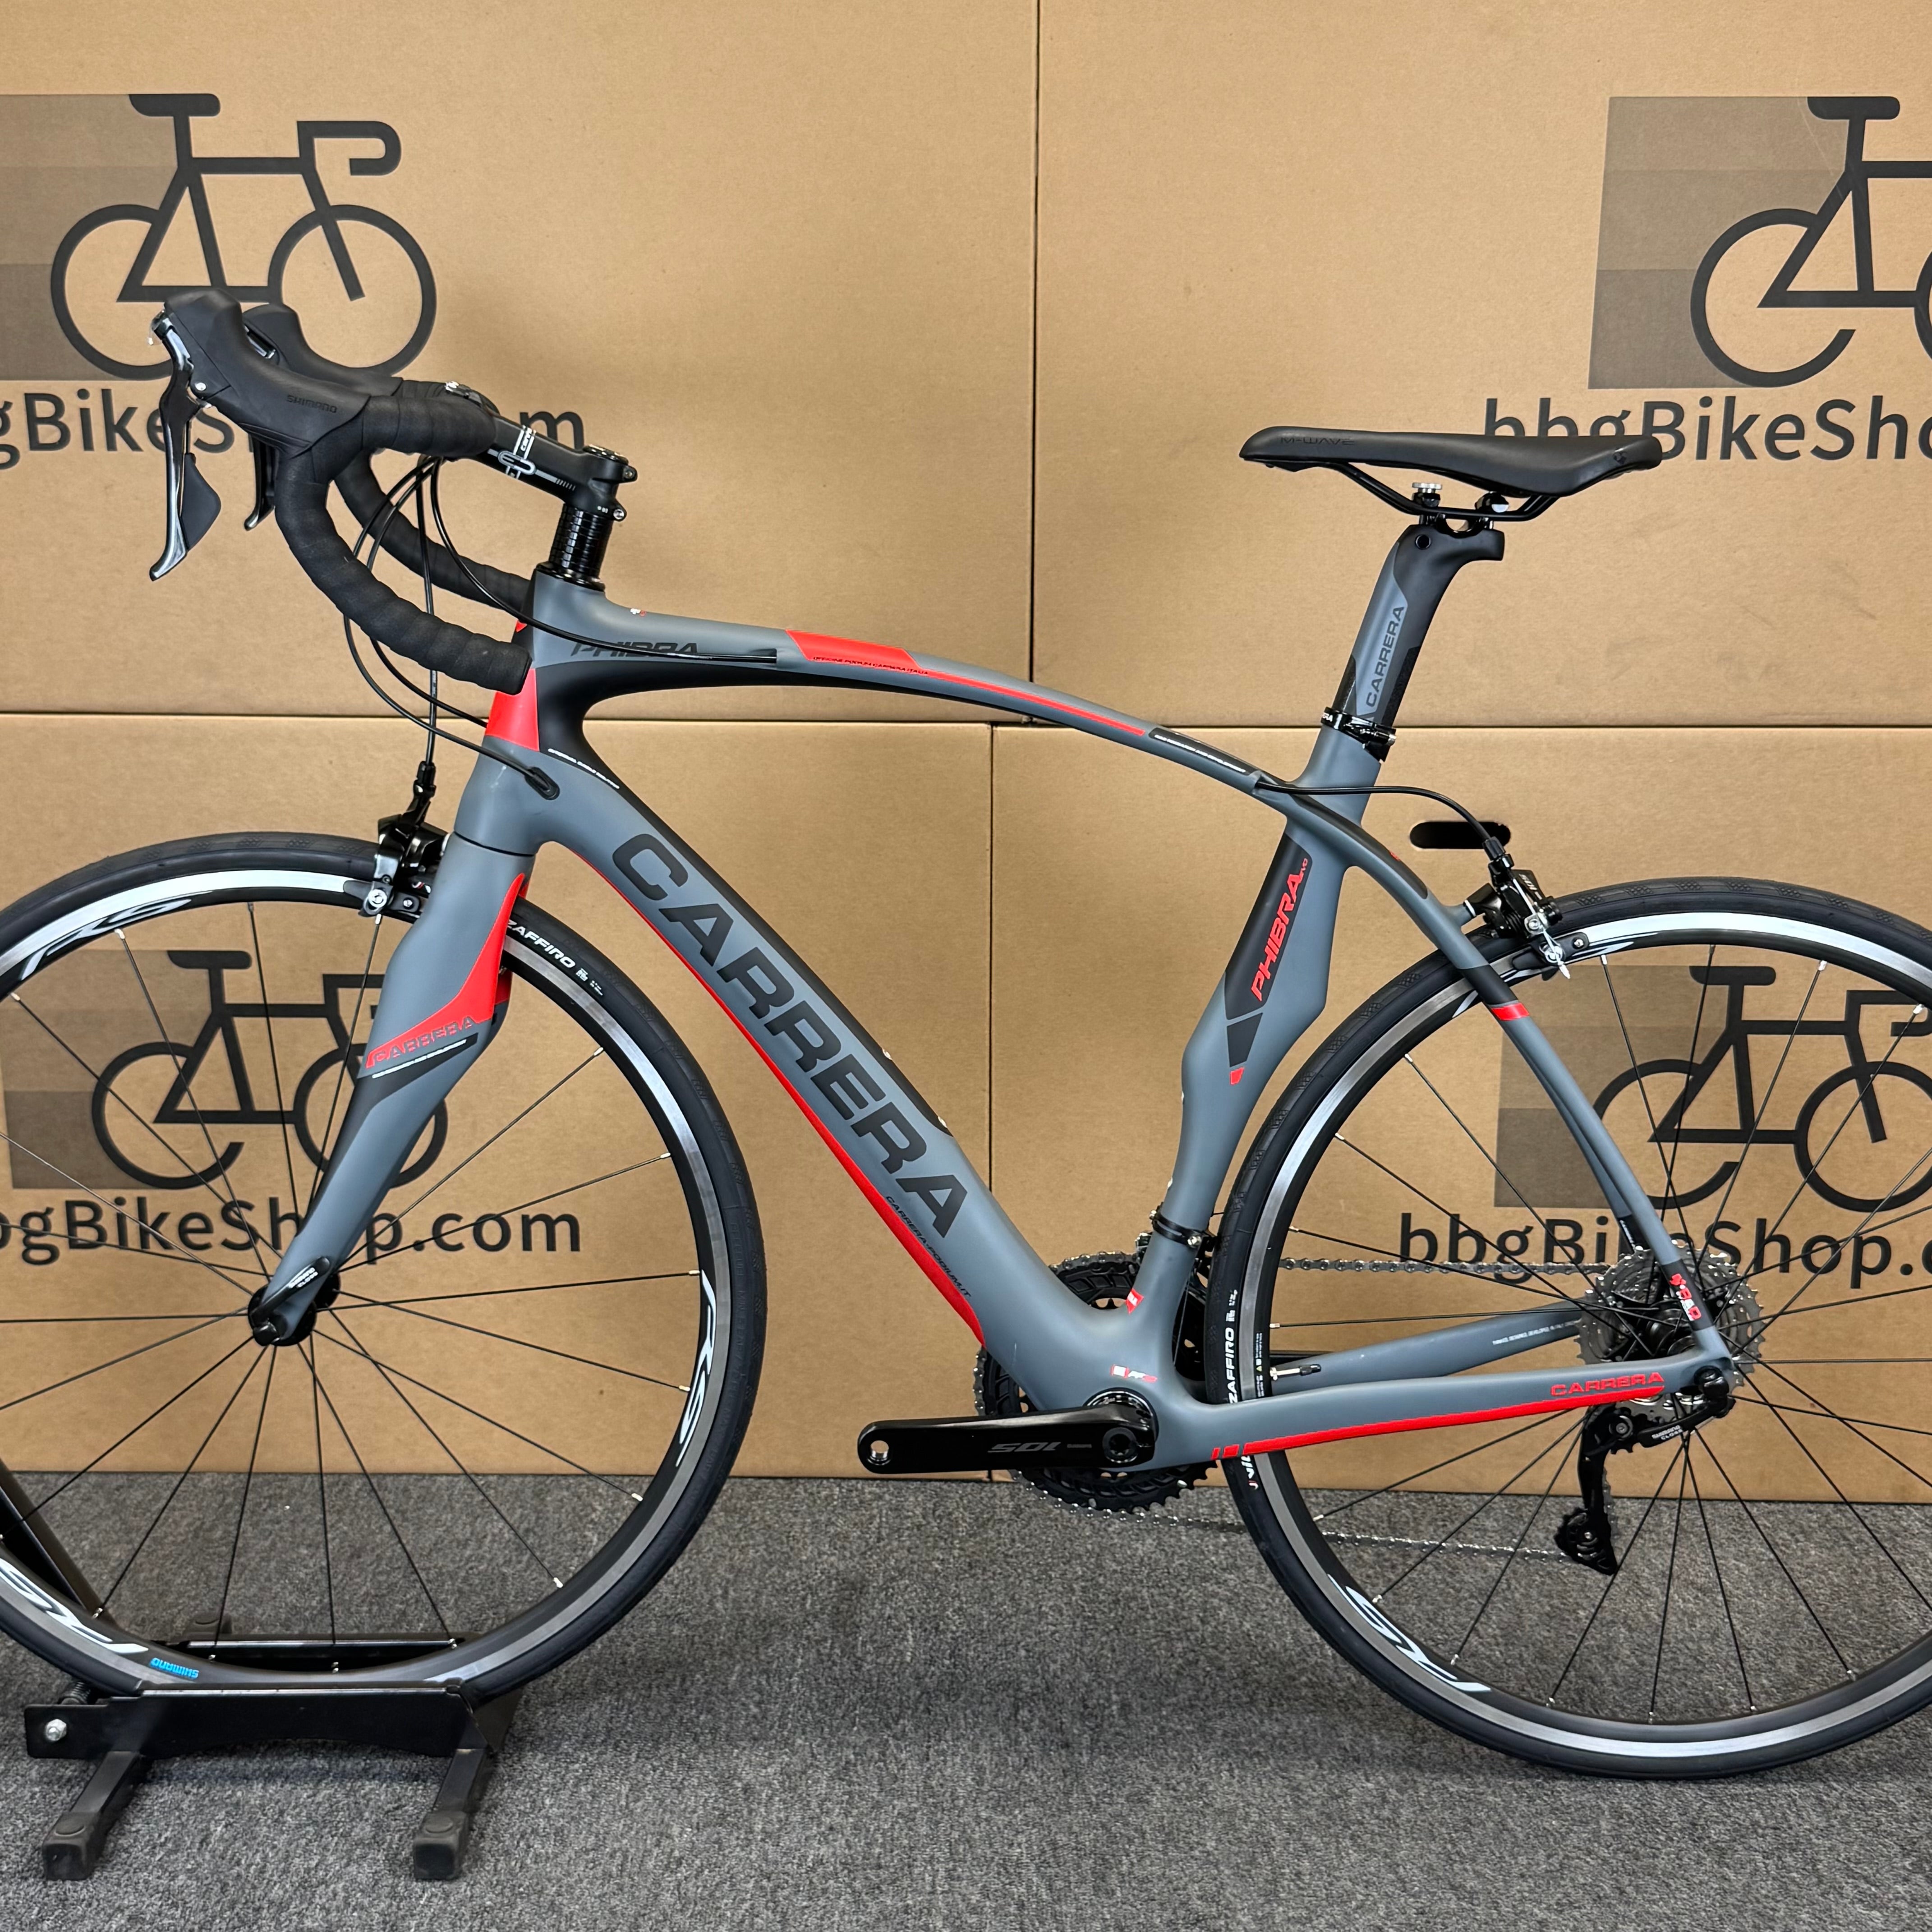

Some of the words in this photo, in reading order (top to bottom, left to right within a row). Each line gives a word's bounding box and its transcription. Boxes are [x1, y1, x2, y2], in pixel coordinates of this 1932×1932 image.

[286, 394, 337, 414] SHIMANO
[1366, 606, 1405, 708] CARRERA
[506, 920, 576, 969] ZAFFIRO
[1251, 873, 1302, 1001] PHIBRA
[373, 1016, 476, 1063] CARRERA
[612, 833, 968, 1238] CARRERA
[1225, 1327, 1238, 1403] ZAFFIRO
[1551, 1372, 1664, 1396] CARRERA
[150, 1658, 199, 1679] SHIMANO
